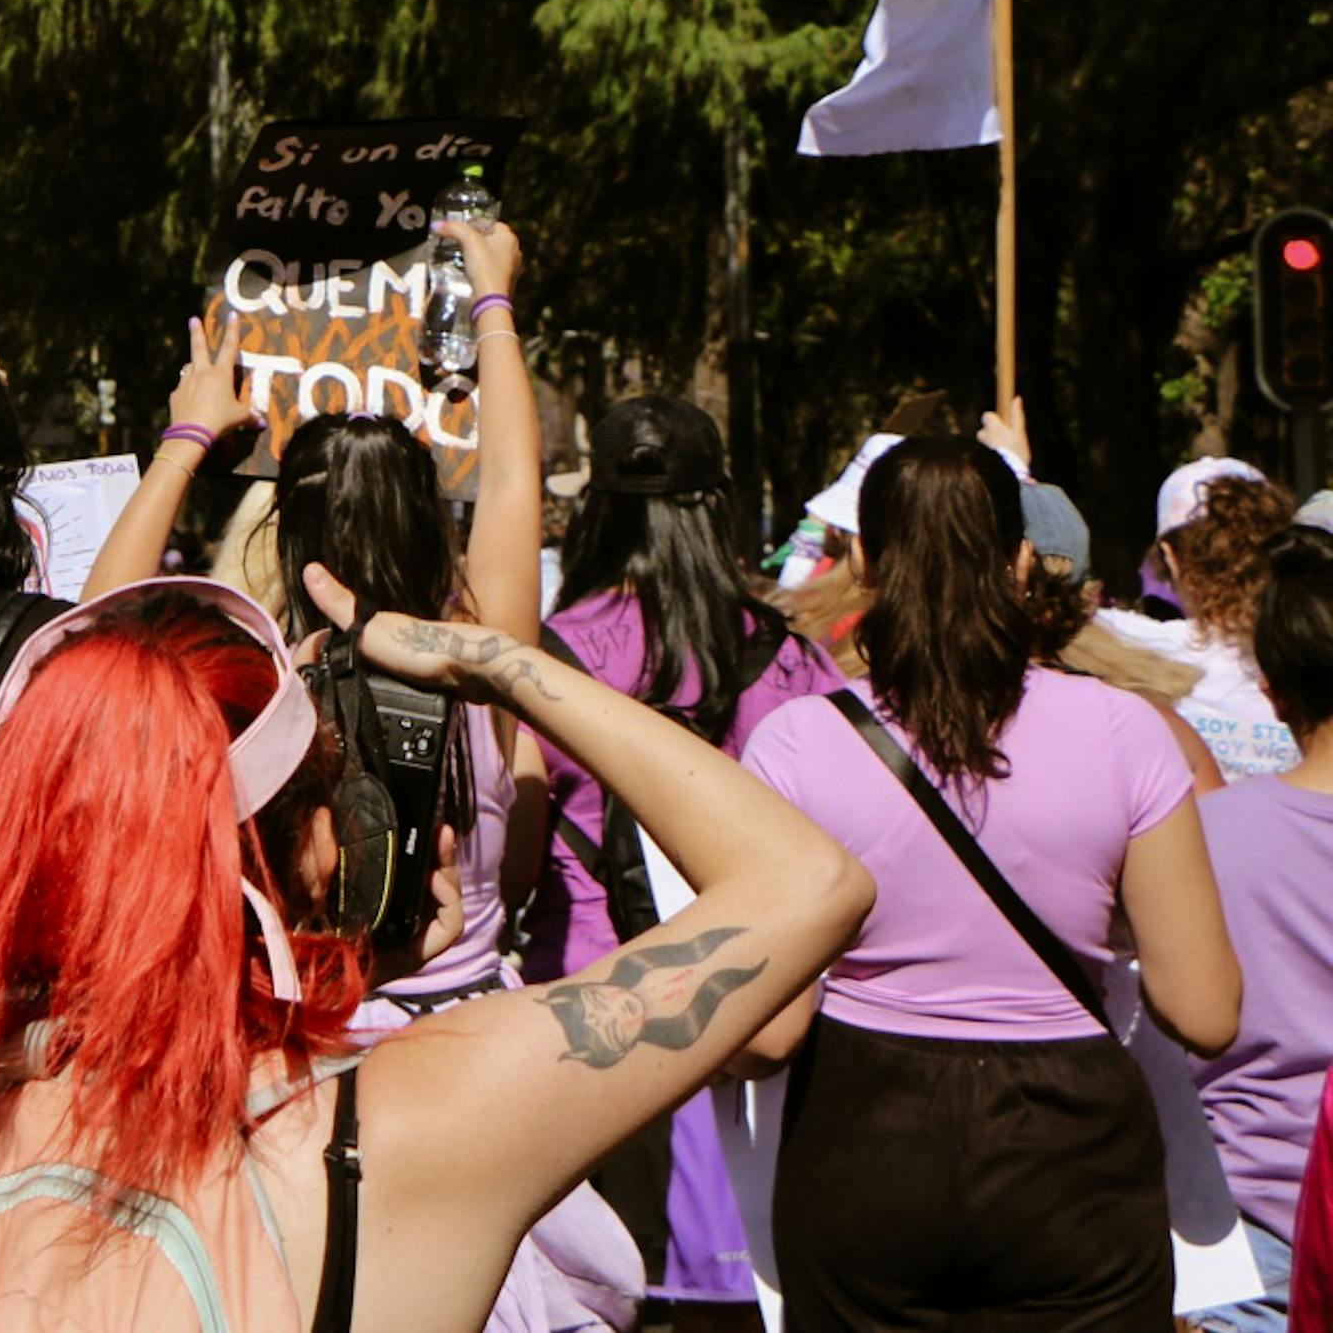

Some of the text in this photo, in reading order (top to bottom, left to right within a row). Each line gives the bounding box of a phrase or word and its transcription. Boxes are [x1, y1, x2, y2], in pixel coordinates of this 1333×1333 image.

[258, 135, 320, 173] Si
[341, 142, 400, 164] un
[1196, 717, 1238, 734] SOY
